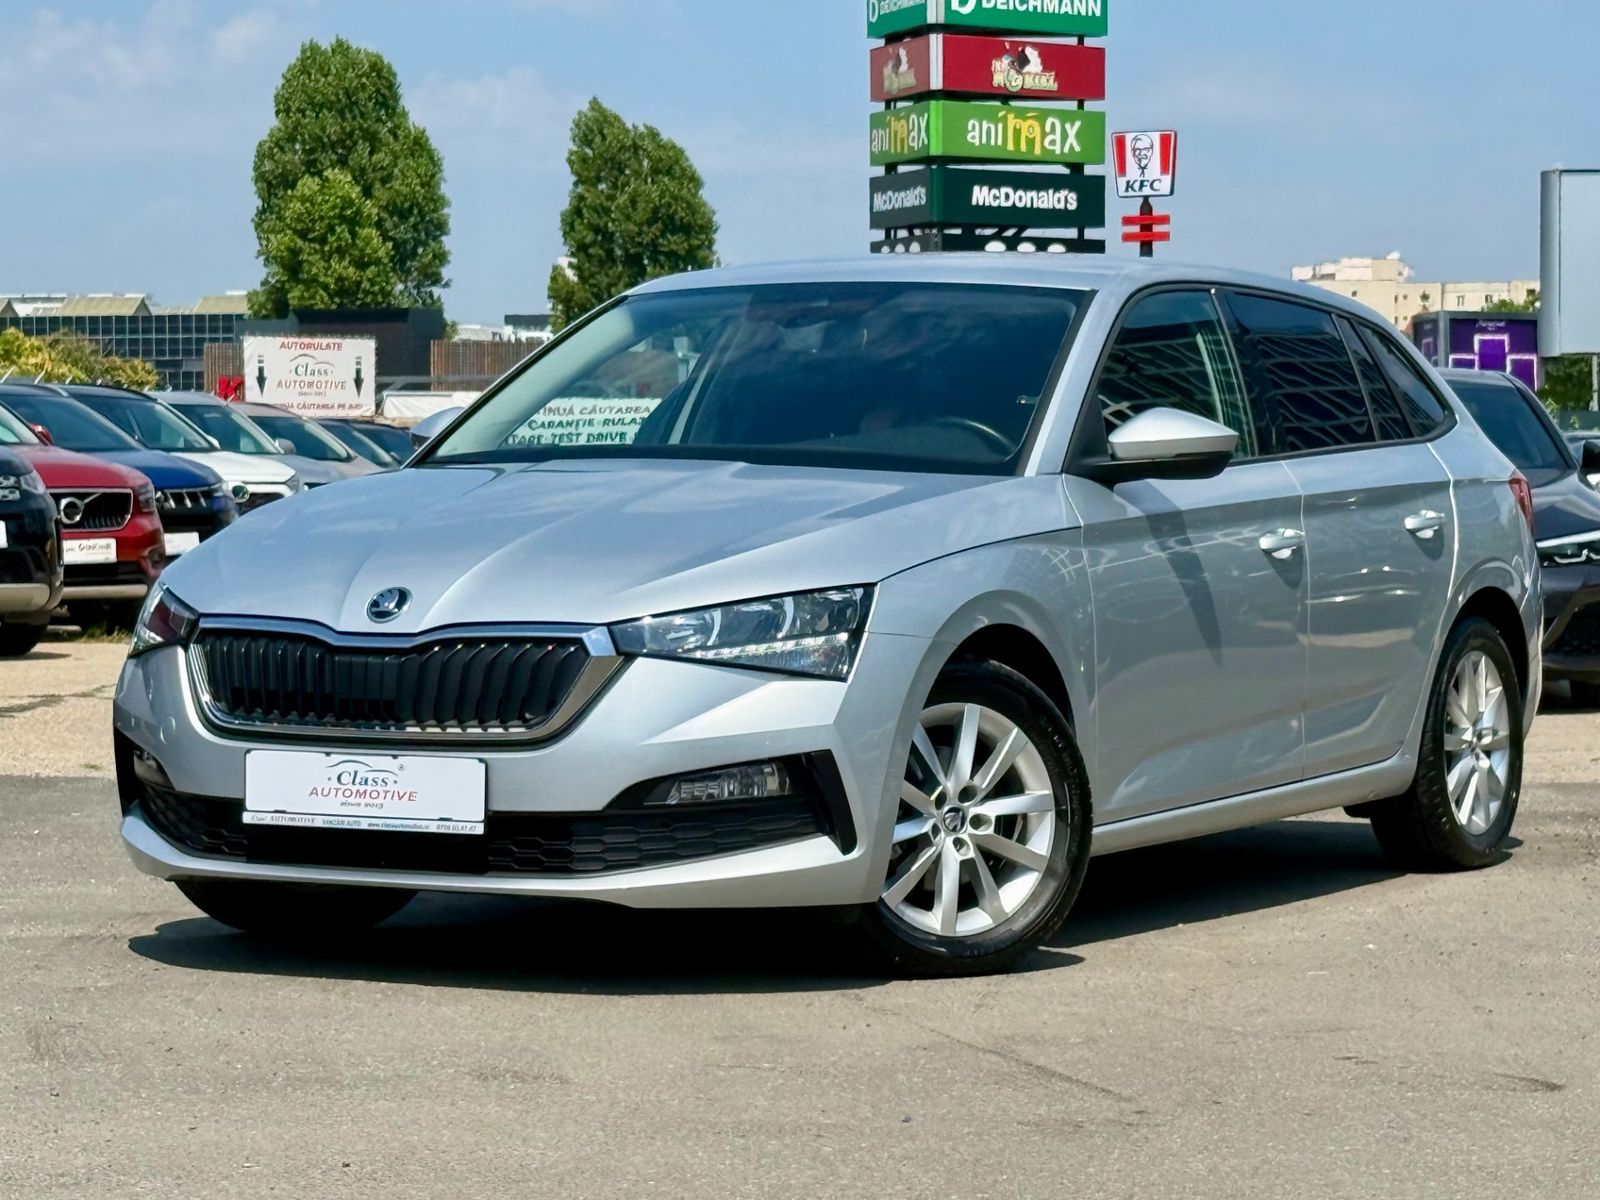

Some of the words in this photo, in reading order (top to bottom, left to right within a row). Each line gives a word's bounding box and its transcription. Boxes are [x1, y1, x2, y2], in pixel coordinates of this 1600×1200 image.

[871, 112, 928, 154] animax
[967, 110, 1082, 155] animax
[1124, 179, 1161, 193] KFC
[873, 185, 926, 212] McDonald's
[972, 185, 1078, 210] McDonald's
[294, 362, 329, 377] Class
[276, 379, 347, 391] AUTOMOTIVE
[551, 432, 582, 445] TEST
[586, 431, 627, 443] DRIVE
[336, 769, 389, 787] Class
[309, 786, 418, 802] AUTOMOTIVE
